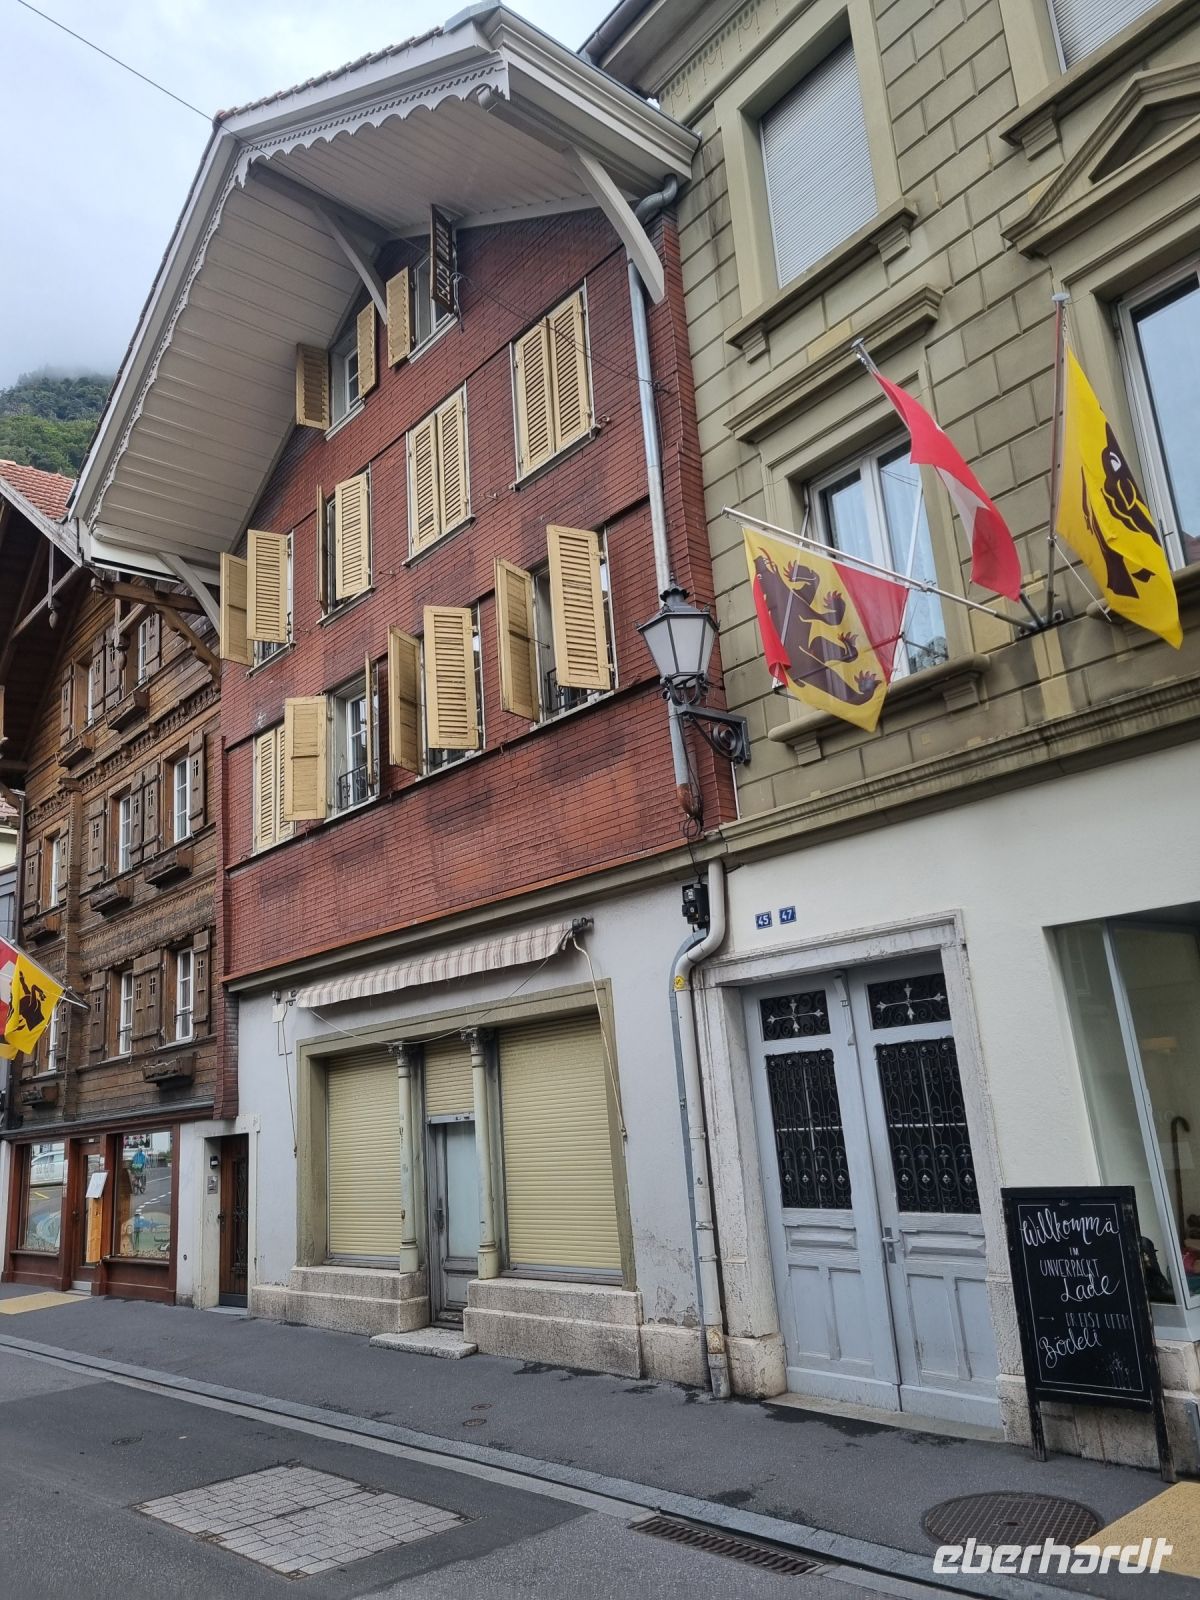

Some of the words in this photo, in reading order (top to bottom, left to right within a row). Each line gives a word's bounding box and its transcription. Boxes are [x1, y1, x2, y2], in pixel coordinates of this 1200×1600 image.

[758, 914, 769, 926] 45
[781, 909, 793, 921] 47
[1020, 1207, 1120, 1247] Willkommä
[1039, 1258, 1101, 1278] UNVERPACKT
[1060, 1273, 1121, 1303] Lade
[1038, 1328, 1103, 1369] Bödeli
